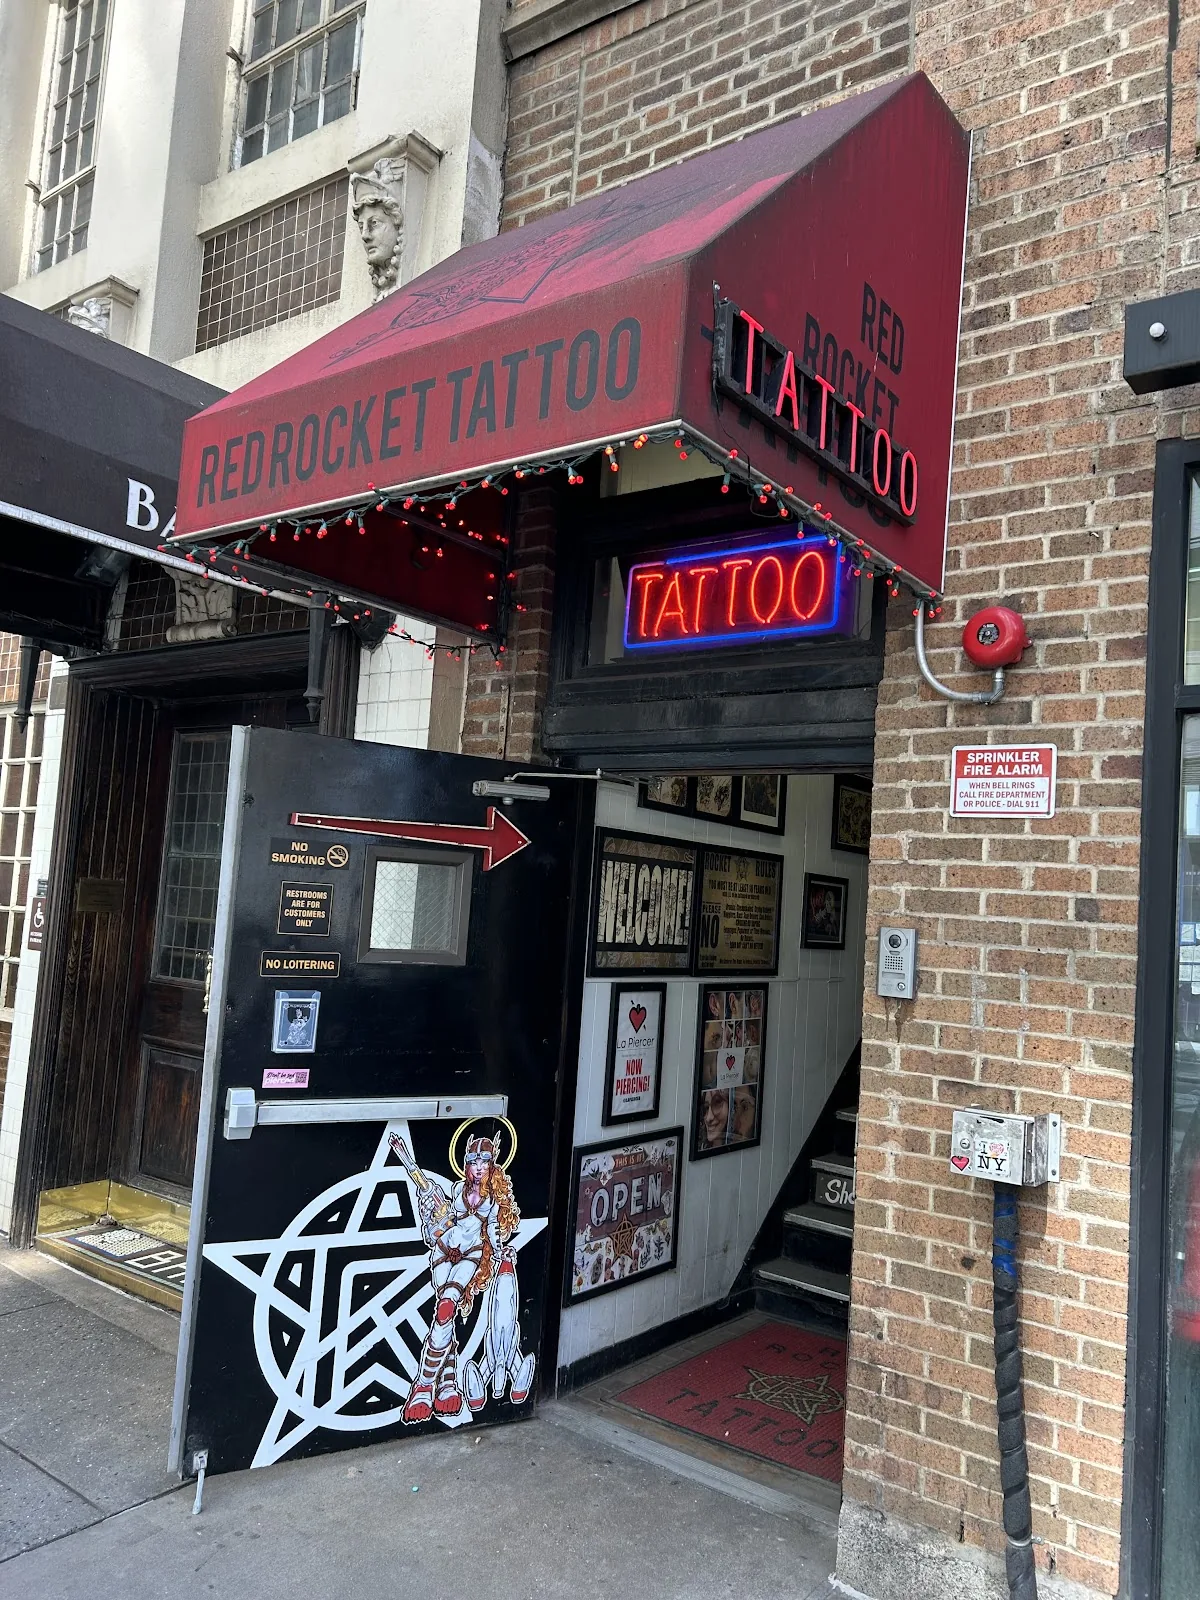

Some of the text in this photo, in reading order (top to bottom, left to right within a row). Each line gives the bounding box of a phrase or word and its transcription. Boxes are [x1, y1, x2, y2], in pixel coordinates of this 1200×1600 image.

[861, 281, 905, 375] RED
[803, 312, 900, 437] ROCKET
[196, 317, 641, 507] RED ROCKET TATTOO
[740, 310, 918, 516] TATTOO
[636, 551, 825, 637] TATTOO
[967, 751, 1039, 763] SPRINKLER
[963, 764, 1042, 775] FIRE ALARM
[1012, 781, 1035, 789] RINGS
[975, 800, 1001, 808] POLICE
[1007, 800, 1024, 808] DIAL
[1025, 800, 1039, 808] 911
[291, 842, 308, 852] NO
[272, 853, 325, 866] SMOKING
[704, 852, 776, 878] ROCKET RULES
[286, 890, 327, 899] RESTROOMS
[291, 900, 320, 908] ARE FOR
[702, 904, 721, 914] PLEASE
[284, 909, 326, 918] CUSTOMERS
[296, 919, 313, 927] ONLY
[701, 914, 720, 948] NO
[266, 959, 335, 970] NO LOITERING
[616, 1036, 655, 1049] La Piercer
[625, 1058, 643, 1077] NOW
[615, 1075, 650, 1096] PIERCING!
[615, 1157, 628, 1168] THIS
[629, 1156, 635, 1165] IS
[977, 1155, 1006, 1172] NY
[590, 1172, 663, 1227] OPEN
[667, 1387, 840, 1460] TATTOO
